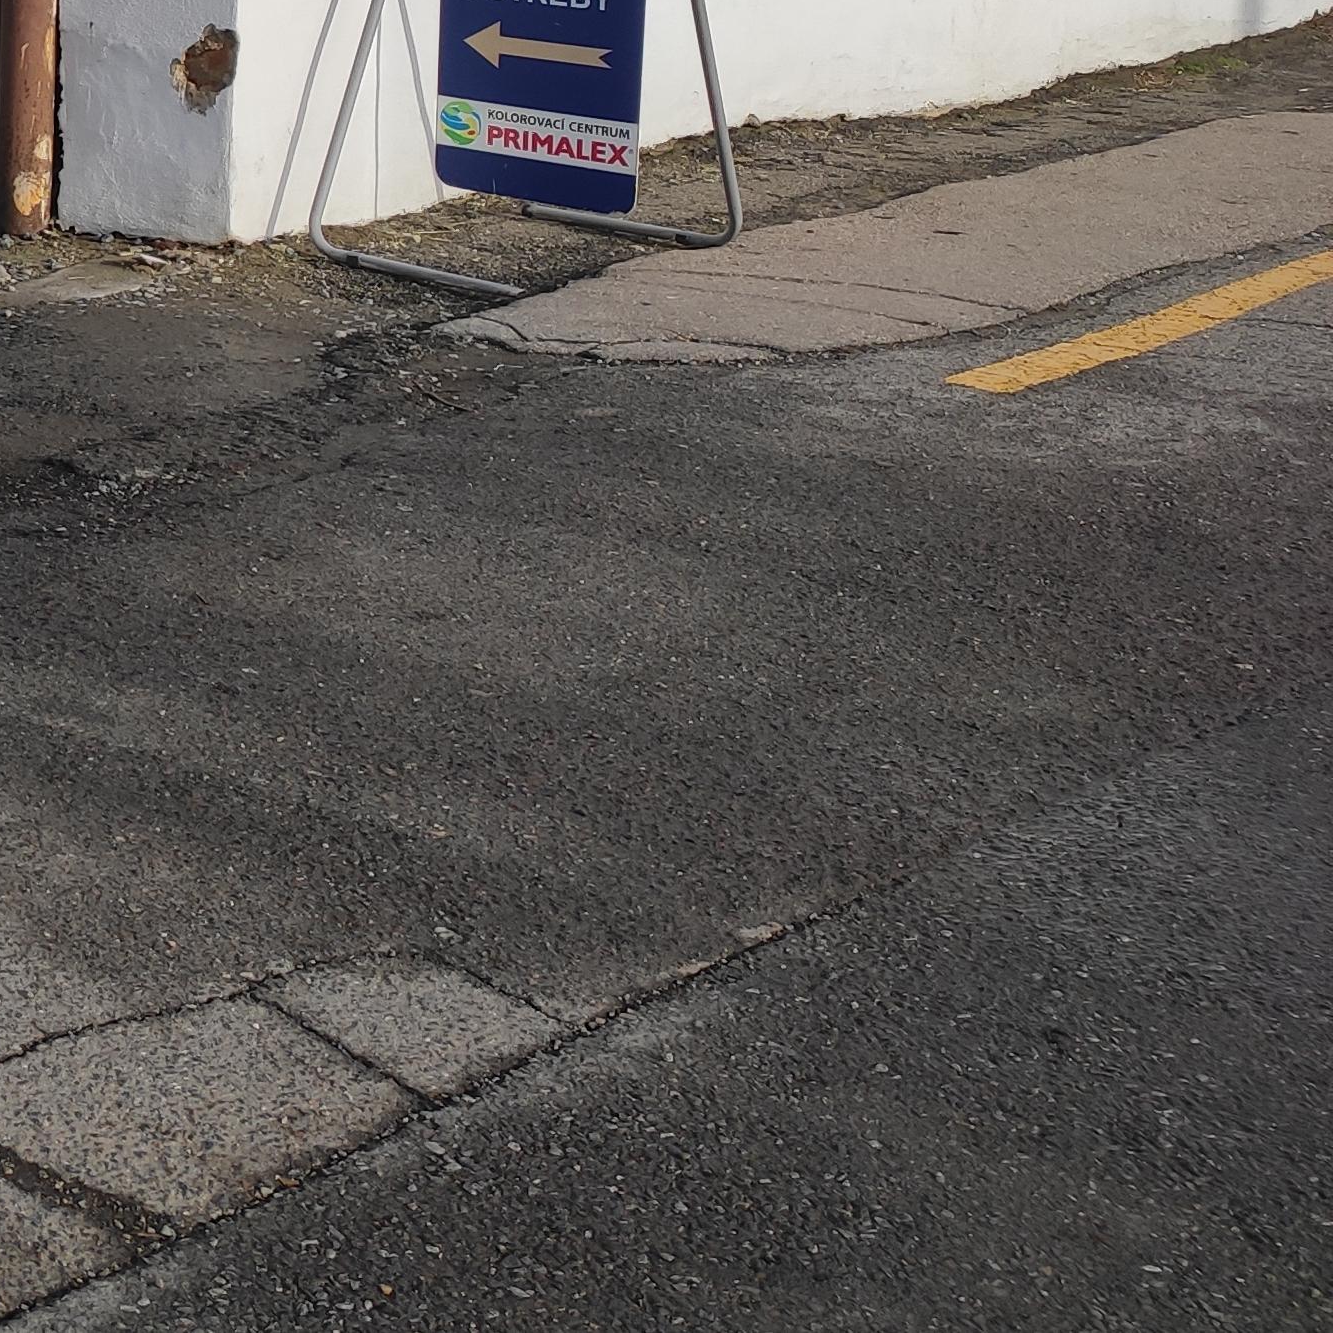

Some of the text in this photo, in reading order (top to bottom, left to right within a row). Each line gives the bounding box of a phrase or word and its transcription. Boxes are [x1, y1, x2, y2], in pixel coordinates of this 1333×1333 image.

[487, 108, 631, 140] KOLOROVACÍ CENTRUM
[486, 125, 630, 167] PRIMALEX
